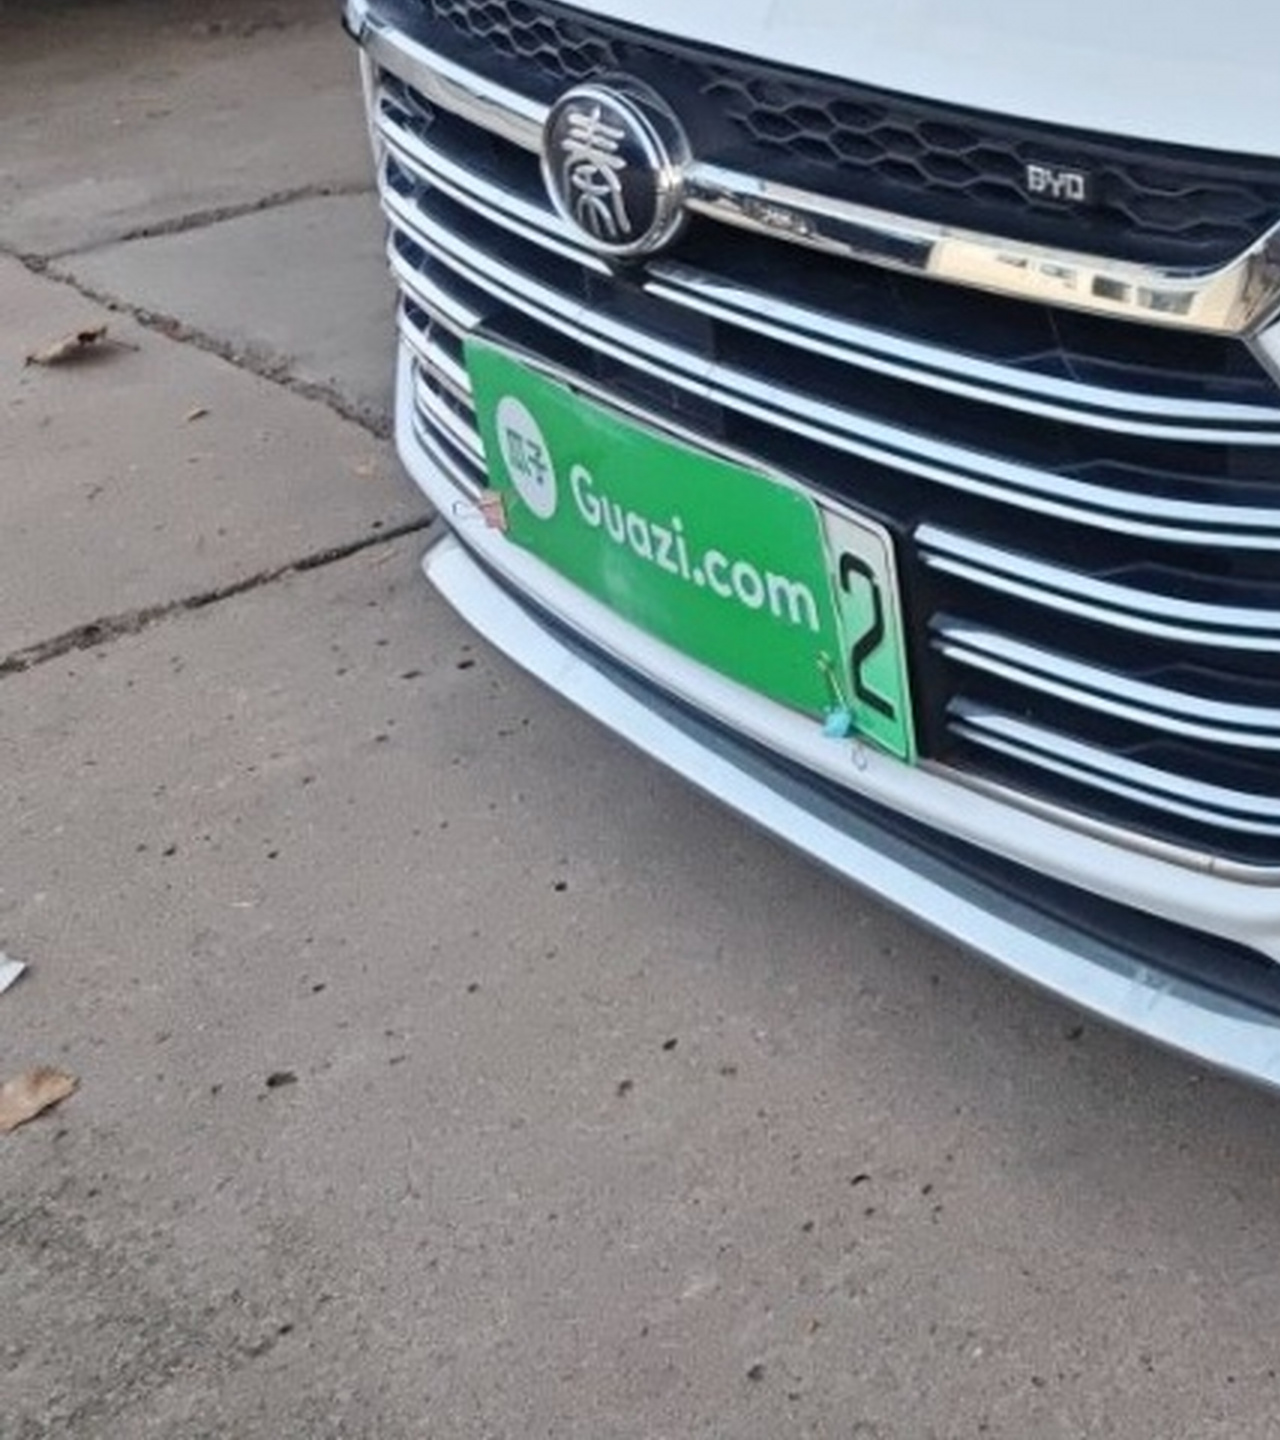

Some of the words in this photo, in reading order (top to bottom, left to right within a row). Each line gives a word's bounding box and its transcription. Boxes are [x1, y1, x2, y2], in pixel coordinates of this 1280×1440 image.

[1026, 164, 1085, 201] BYD
[569, 463, 821, 633] Guazi.com
[839, 551, 896, 720] 2
